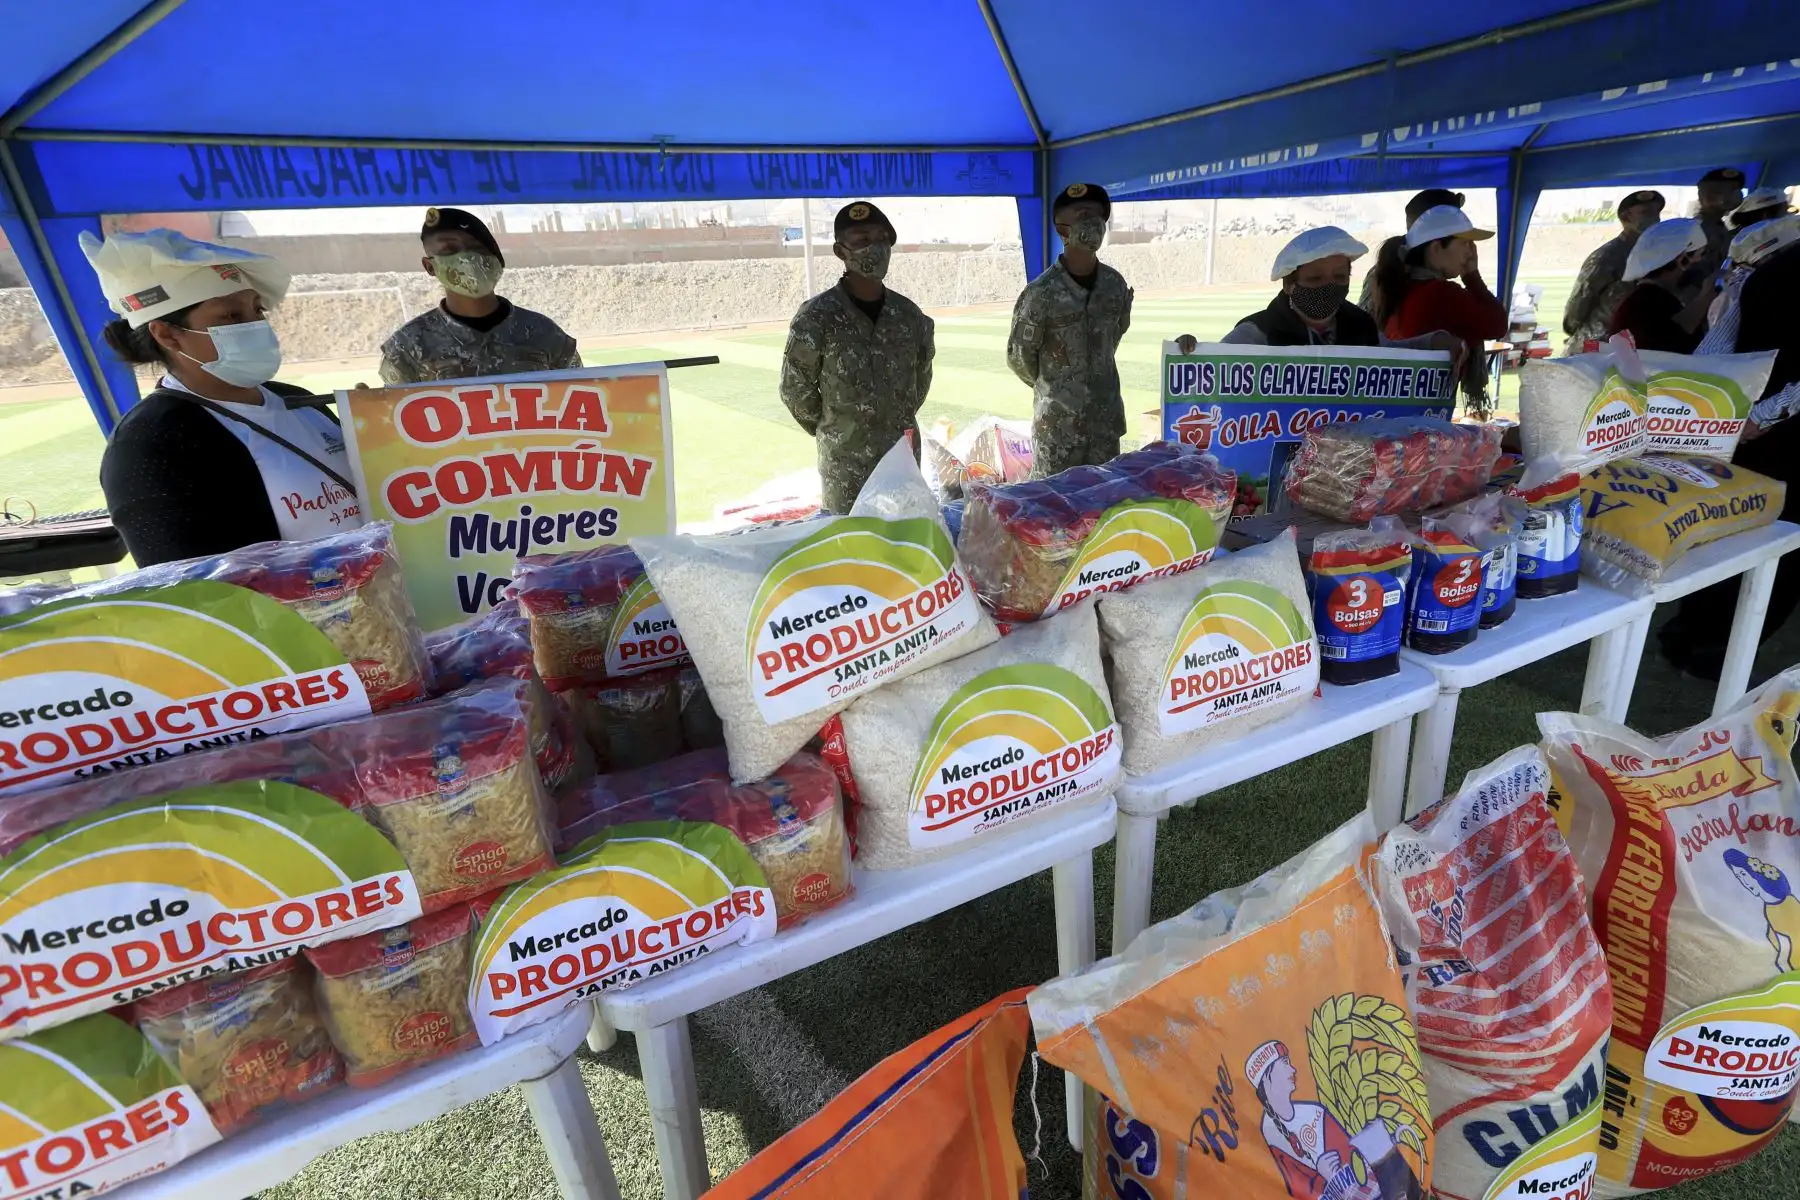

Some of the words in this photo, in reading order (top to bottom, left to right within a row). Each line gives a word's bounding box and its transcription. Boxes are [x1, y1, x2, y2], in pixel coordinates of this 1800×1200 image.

[1168, 362, 1215, 396] UPIS
[1219, 362, 1255, 396] LOS
[1260, 364, 1353, 397] CLAVELES
[1353, 366, 1414, 399] PARTE
[400, 388, 608, 443] OLLA
[1219, 408, 1282, 447] OLLA
[1596, 408, 1631, 425] Mercado
[1647, 416, 1744, 435] ODUCTORES
[1650, 436, 1681, 446] SANTA
[1682, 438, 1709, 447] ANITA
[387, 443, 653, 519] COMÚN
[450, 505, 618, 558] Mujeres
[1663, 507, 1700, 544] Arroz
[1697, 501, 1729, 522] Don
[1729, 492, 1768, 518] Cotty
[1078, 560, 1141, 586] Mercado
[1453, 559, 1474, 584] 3
[1347, 579, 1368, 608] 3
[1440, 583, 1478, 598] Bolsas
[757, 567, 965, 681] PRODUCTORES
[768, 594, 868, 640] Mercado
[1334, 608, 1379, 622] Bolsas
[619, 634, 688, 661] PRO
[826, 673, 869, 698] Donde
[872, 651, 916, 682] comprar
[931, 620, 966, 650] ahorrar
[834, 650, 891, 683] SANTA
[894, 624, 939, 658] ANITA
[1184, 643, 1240, 670] Mercado
[1170, 641, 1312, 701] PRODUCTORES
[0, 687, 133, 729] ercado
[1213, 693, 1249, 711] SANTA
[1251, 681, 1282, 702] ANITA
[0, 669, 349, 773] RODUCTORES
[1206, 708, 1233, 723] Donde
[924, 728, 1115, 820] PRODUCTORES
[941, 746, 1025, 785] Mercado
[983, 796, 1031, 822] SANTA
[1035, 779, 1079, 805] ANITA
[1652, 768, 1730, 801] Linda
[973, 815, 1010, 834] Donde
[1012, 799, 1053, 823] comprar
[453, 845, 506, 869] Espiga
[477, 859, 502, 874] Oro
[793, 877, 831, 898] Espiga
[810, 890, 828, 902] Oro
[0, 876, 404, 1005] PRODUCTORES
[2, 899, 190, 955] Mercado
[509, 905, 629, 962] Mercado
[1607, 828, 1664, 1037] FERREÑAFANA
[488, 889, 765, 1001] PRODUCTORES
[576, 968, 642, 999] SANTA
[648, 944, 710, 976] ANITA
[394, 1015, 449, 1043] Espiga
[420, 1031, 447, 1045] Oro
[1698, 1026, 1790, 1048] Mercado
[1716, 1086, 1756, 1097] Donde
[1730, 1077, 1780, 1089] SANTA
[1668, 1119, 1688, 1131] Kg
[1669, 1107, 1694, 1121] 49
[0, 1091, 190, 1189] TORES
[1518, 1160, 1593, 1195] Mercado
